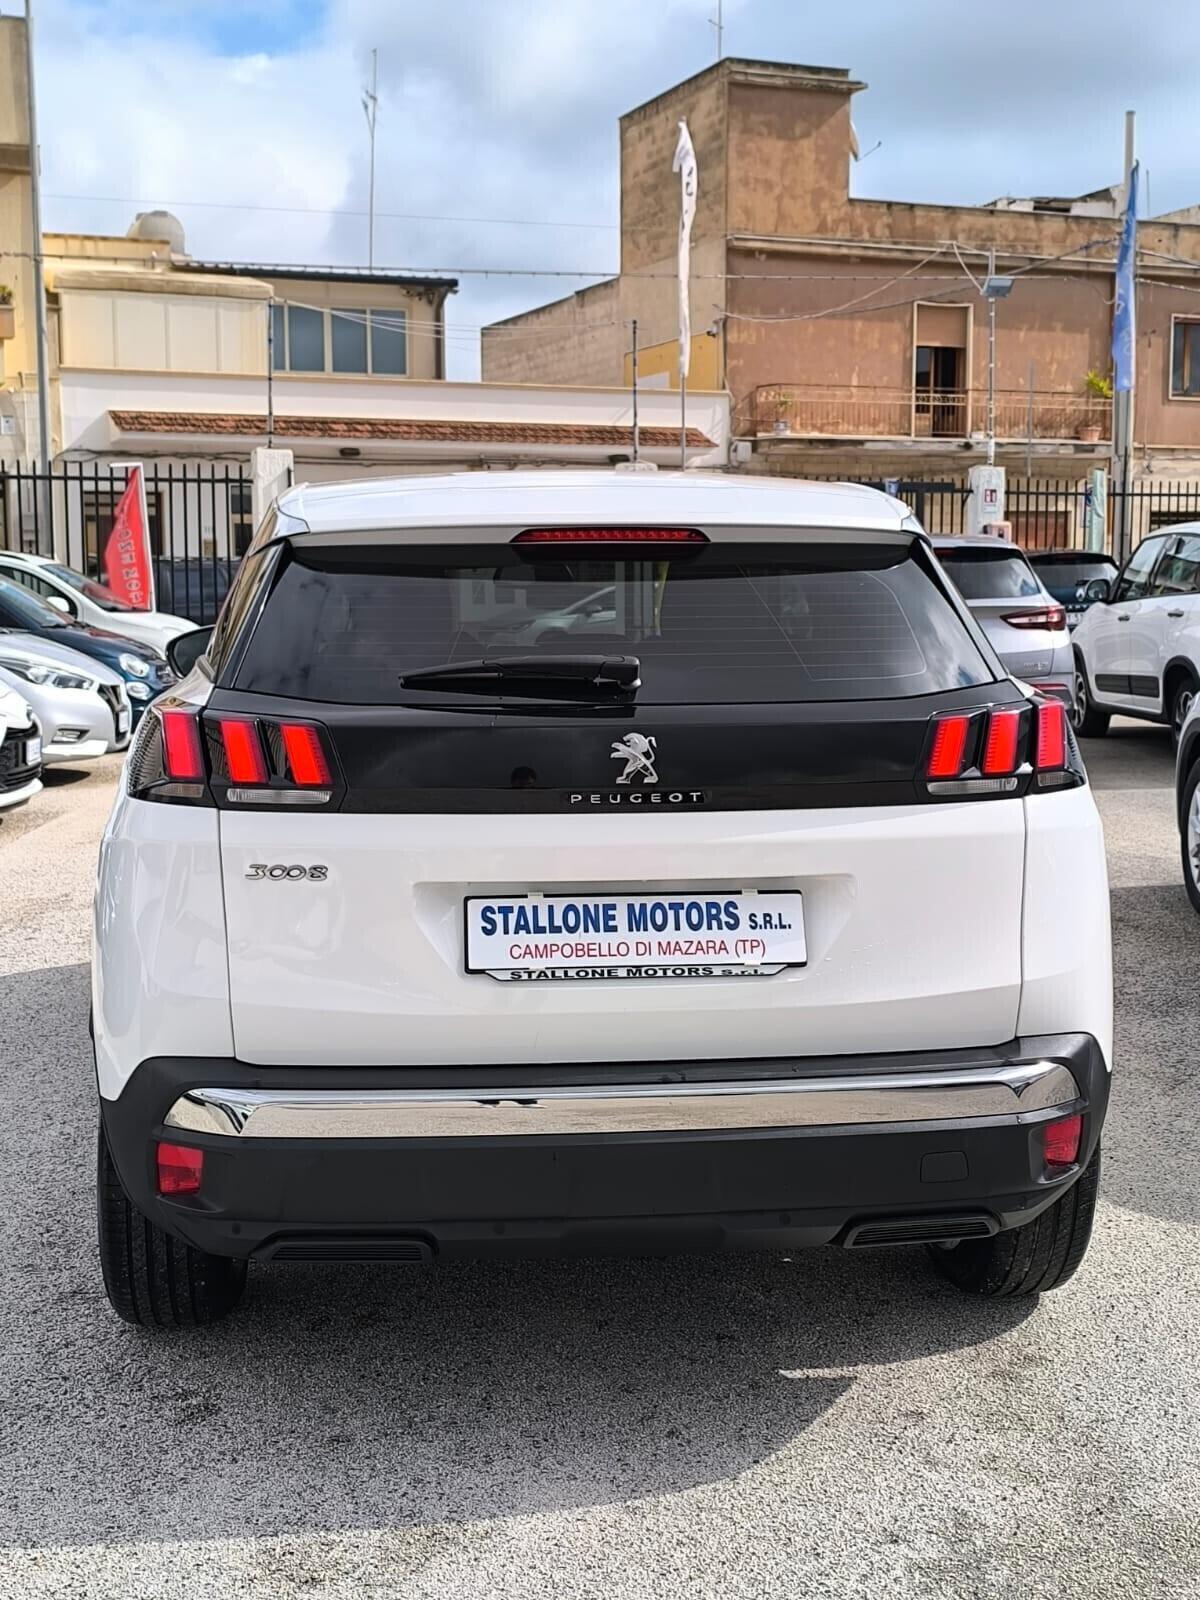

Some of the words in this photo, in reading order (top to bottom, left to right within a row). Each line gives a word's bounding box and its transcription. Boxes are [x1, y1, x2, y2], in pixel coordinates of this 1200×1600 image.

[570, 792, 702, 804] PEUGEOT
[244, 863, 328, 882] 3008
[480, 903, 618, 936] STALLONE
[627, 901, 741, 932] MOTORS
[748, 913, 792, 930] S.R.L.
[509, 941, 630, 960] CAMPOBELLO
[635, 941, 652, 957] DI
[658, 939, 729, 956] MAZARA
[734, 939, 766, 959] (TP)
[510, 968, 619, 980] STALLONE
[626, 966, 714, 977] MOTORS
